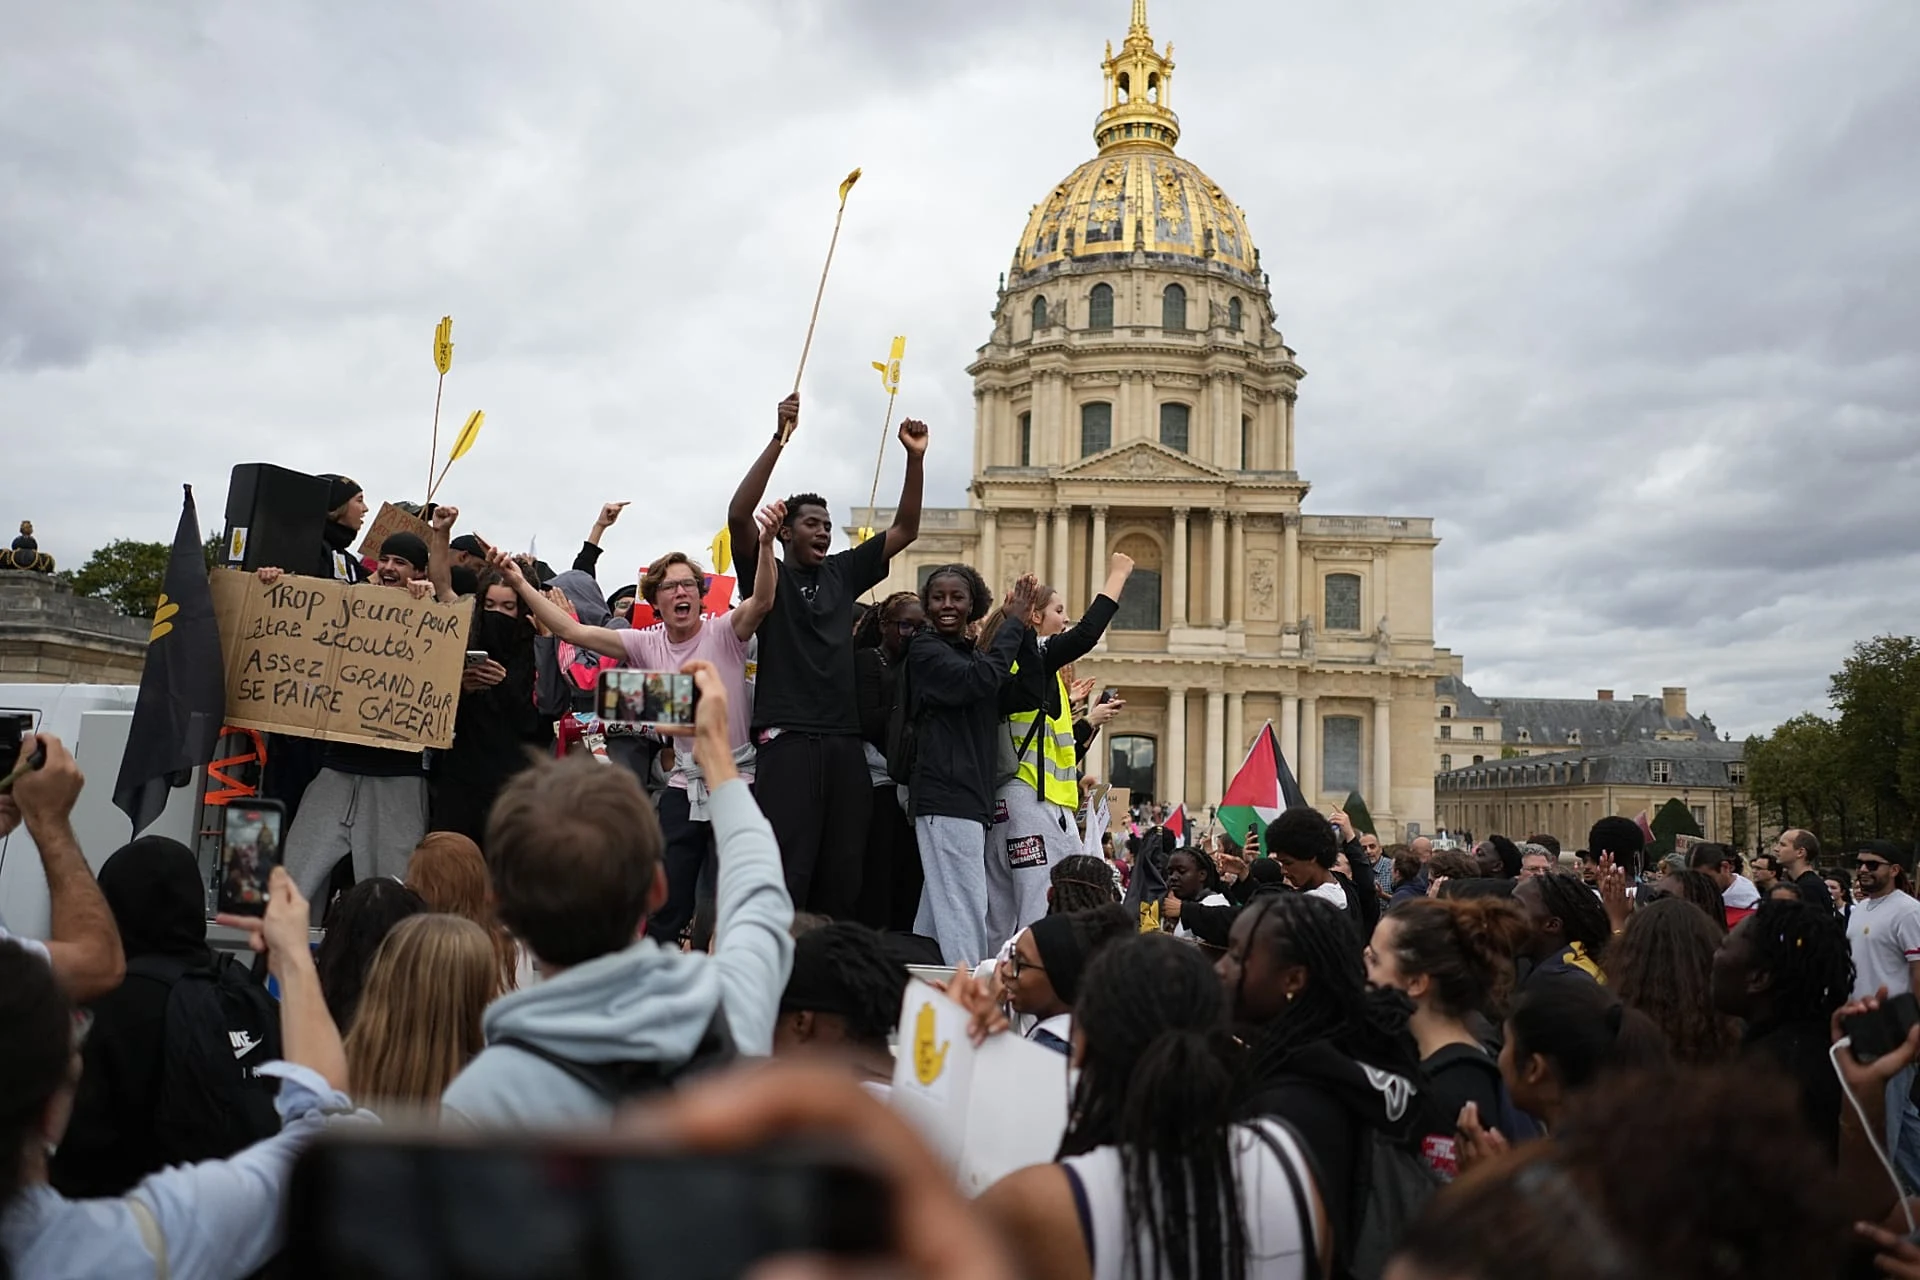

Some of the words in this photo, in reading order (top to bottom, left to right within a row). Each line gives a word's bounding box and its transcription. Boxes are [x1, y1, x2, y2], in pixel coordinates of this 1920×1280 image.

[264, 582, 325, 620] TROP
[237, 678, 265, 702] SE
[340, 665, 415, 698] GRAND
